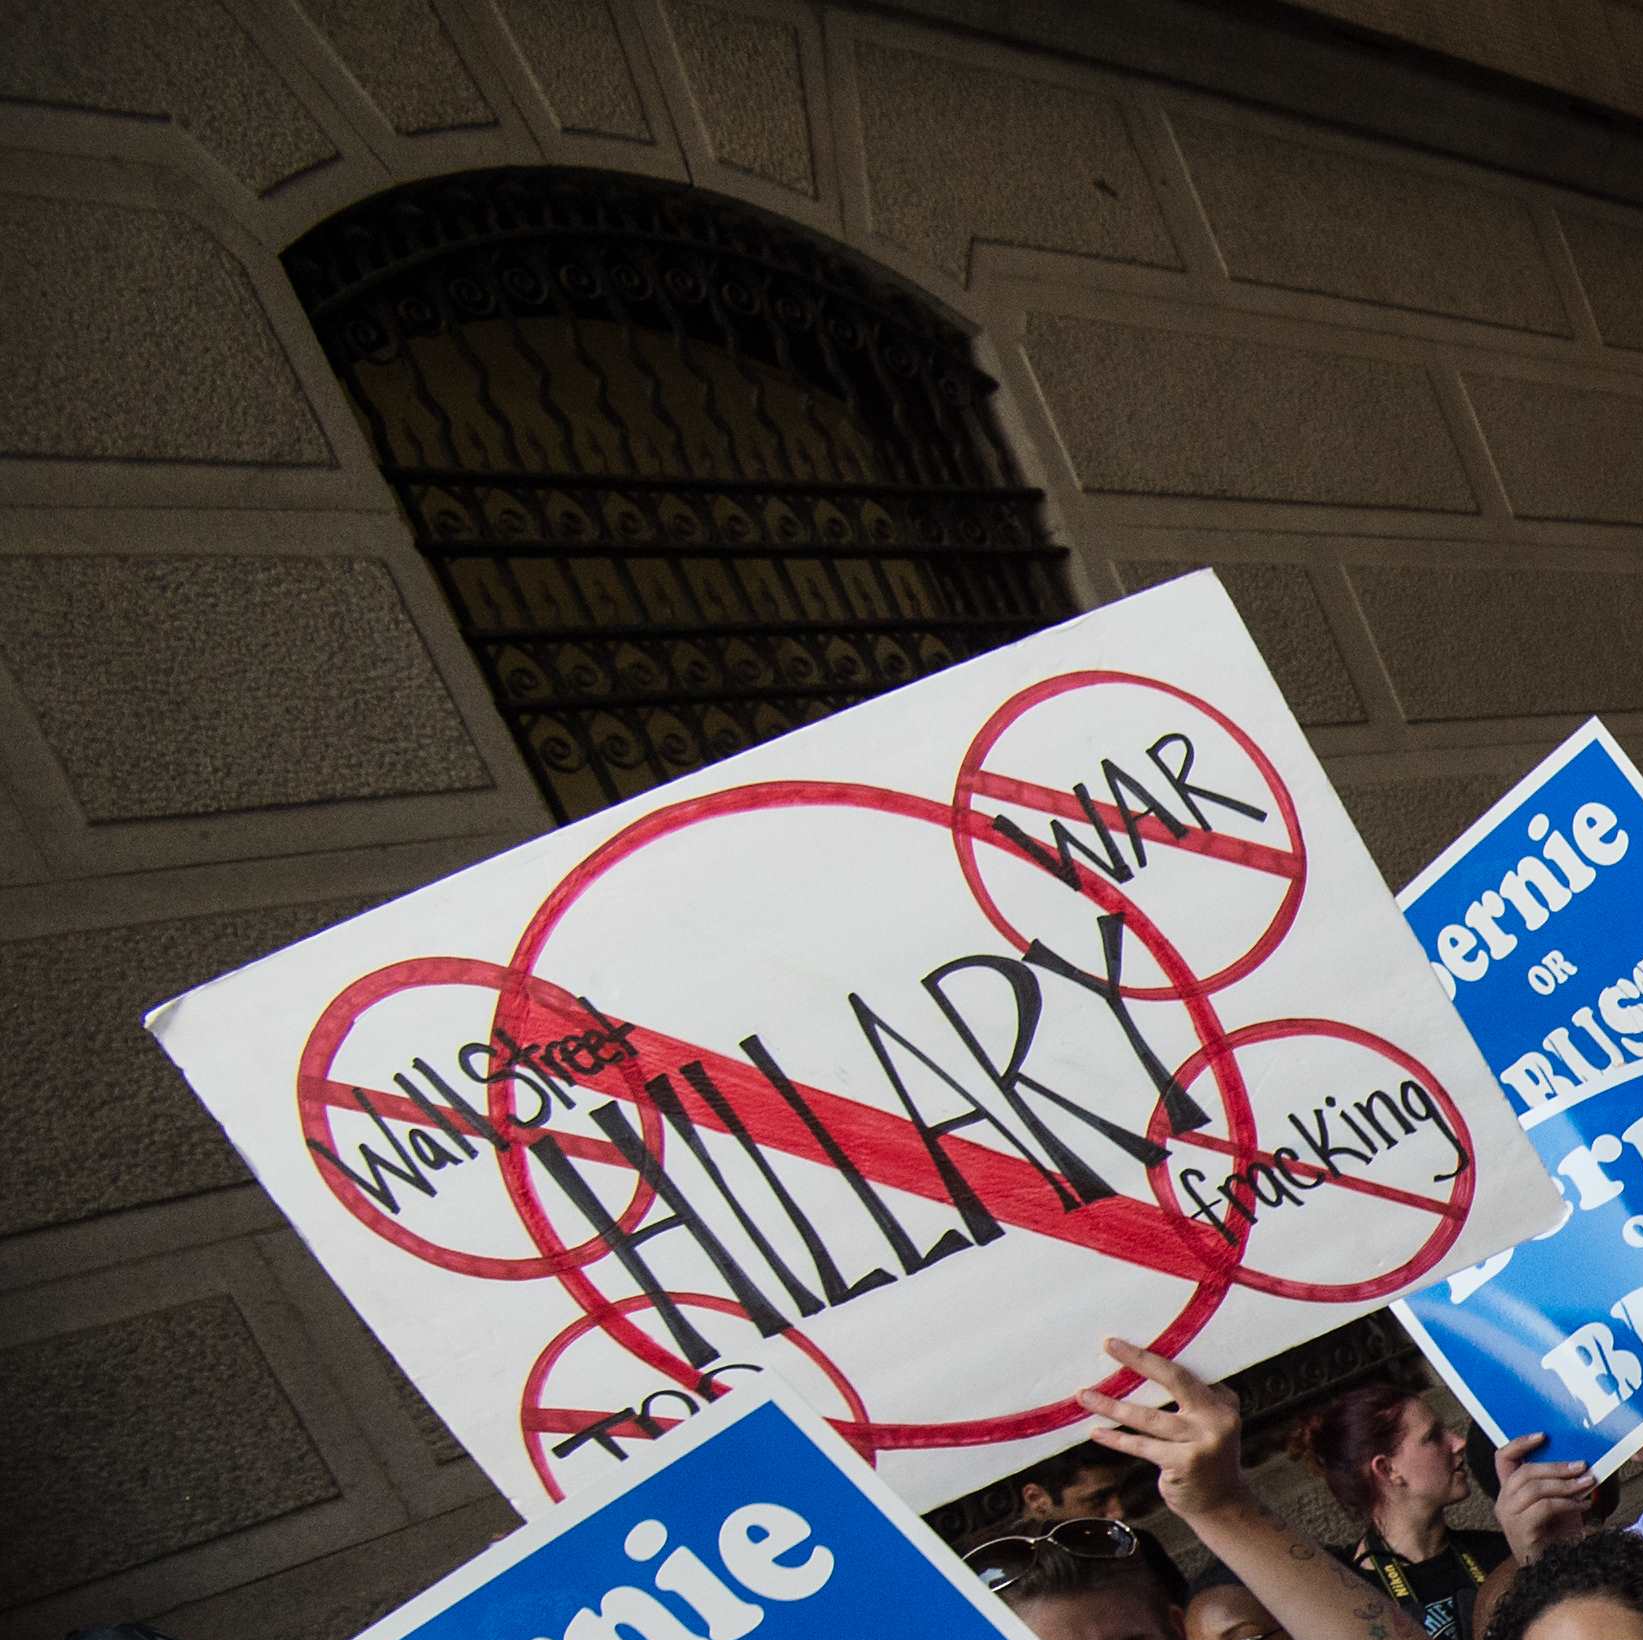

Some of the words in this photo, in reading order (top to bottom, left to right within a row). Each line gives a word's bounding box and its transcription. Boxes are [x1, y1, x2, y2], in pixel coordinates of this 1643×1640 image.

[991, 731, 1268, 893] WAR
[1527, 950, 1578, 996] OR
[306, 1052, 492, 1214] Wall
[463, 995, 637, 1128] Street
[530, 911, 1210, 1368] HILLARY
[1383, 1564, 1409, 1598] Nikon
